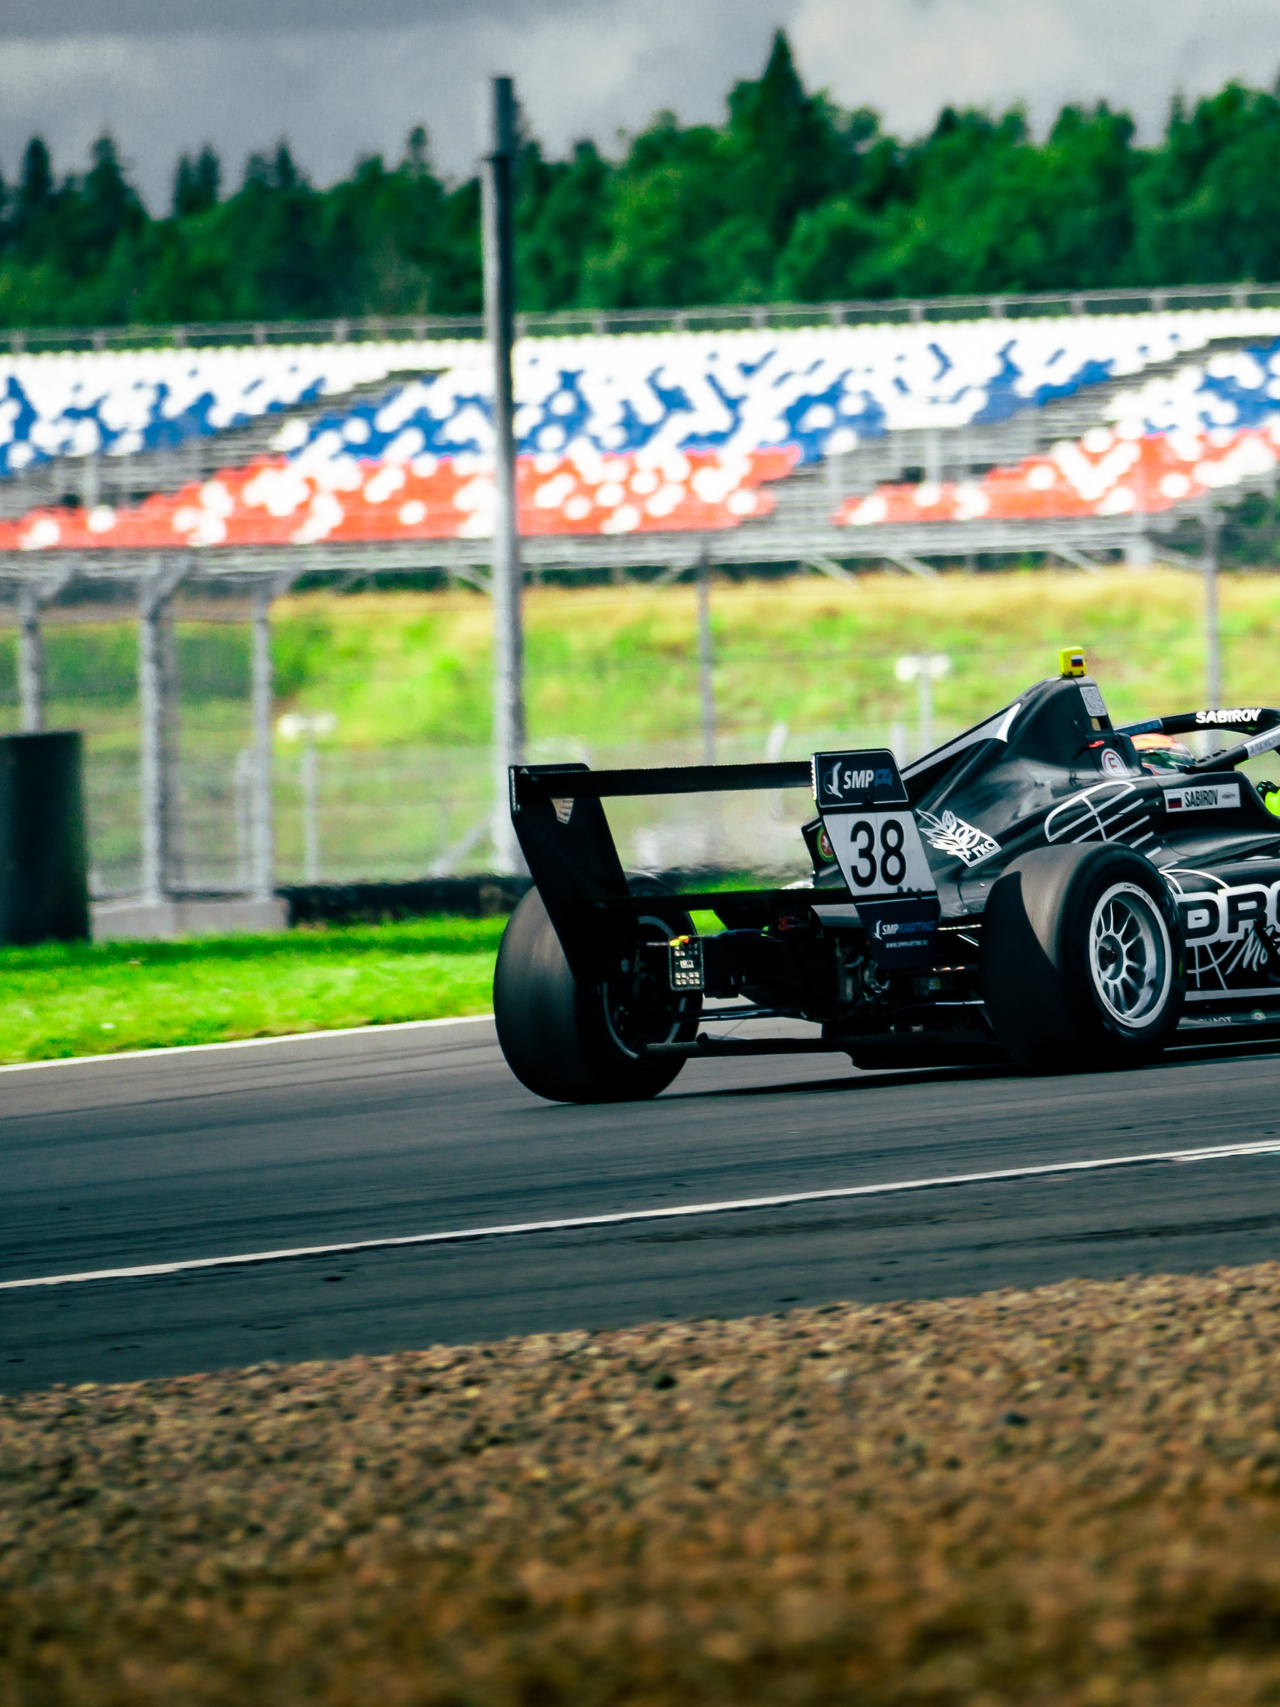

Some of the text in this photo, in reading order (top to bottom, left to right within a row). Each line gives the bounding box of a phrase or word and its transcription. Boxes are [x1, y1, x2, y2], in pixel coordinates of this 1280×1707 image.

[1195, 708, 1262, 724] SABIROV
[1108, 757, 1122, 775] E
[843, 769, 875, 790] SMP
[1184, 789, 1218, 808] SABIROV
[850, 819, 907, 888] 38
[971, 840, 995, 858] ГКС
[881, 923, 899, 936] SMP
